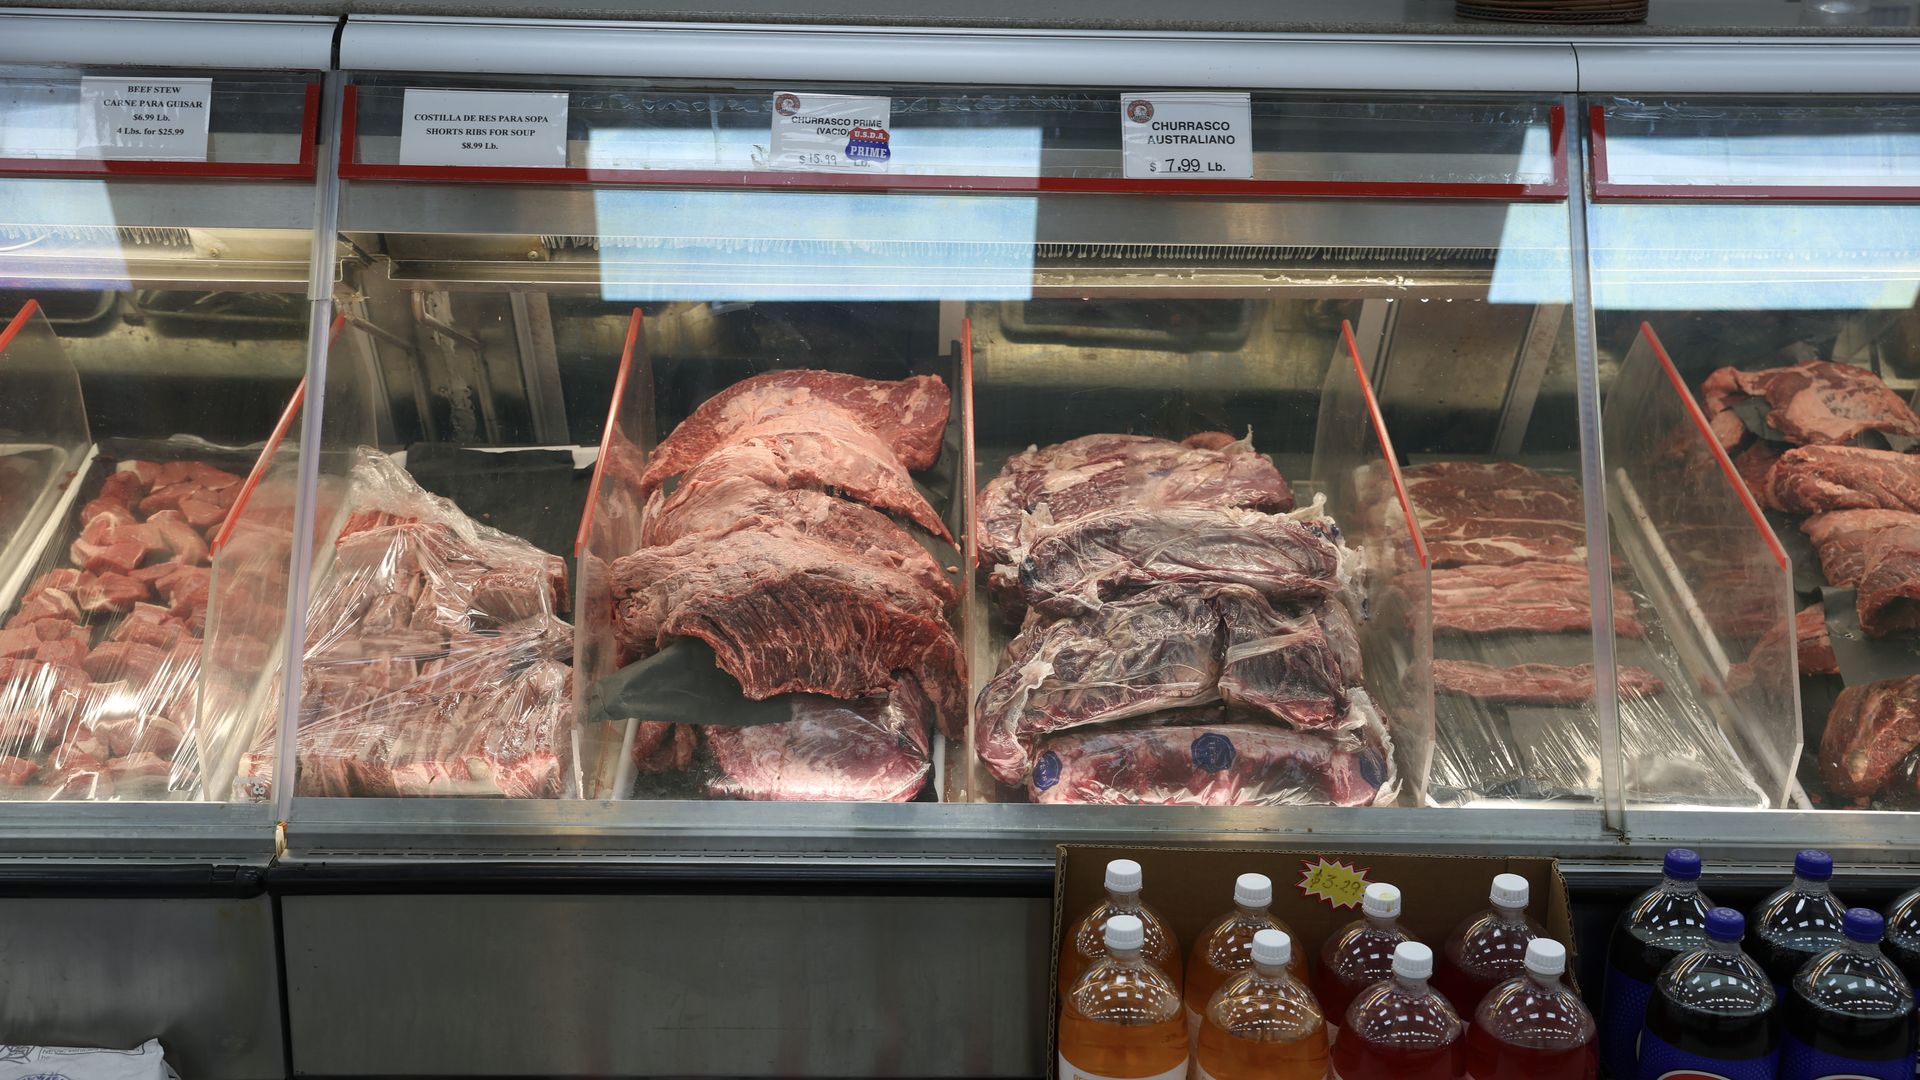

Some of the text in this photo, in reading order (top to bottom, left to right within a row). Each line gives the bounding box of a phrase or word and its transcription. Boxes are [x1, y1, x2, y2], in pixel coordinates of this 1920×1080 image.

[154, 86, 181, 94] STEW
[104, 99, 137, 107] CARNE
[140, 100, 164, 108] PARA
[157, 114, 170, 122] Lb.
[414, 114, 461, 122] COSTILLA
[464, 114, 476, 122] DE
[479, 114, 496, 122] RES
[499, 115, 522, 123] PARA
[791, 116, 882, 128] CHURRASCO PRIME
[1151, 121, 1230, 131] CHURRASCO
[144, 127, 156, 135] for
[158, 127, 184, 136] $25.99
[426, 128, 463, 136] SHORTS
[854, 130, 886, 140] U.S.D.A.
[1147, 134, 1236, 145] AUSTRALIANO
[462, 142, 498, 150] $8.99 Lb.
[850, 145, 887, 159] PRIME
[1165, 158, 1201, 173] 7.99
[1207, 161, 1226, 172] Lb.
